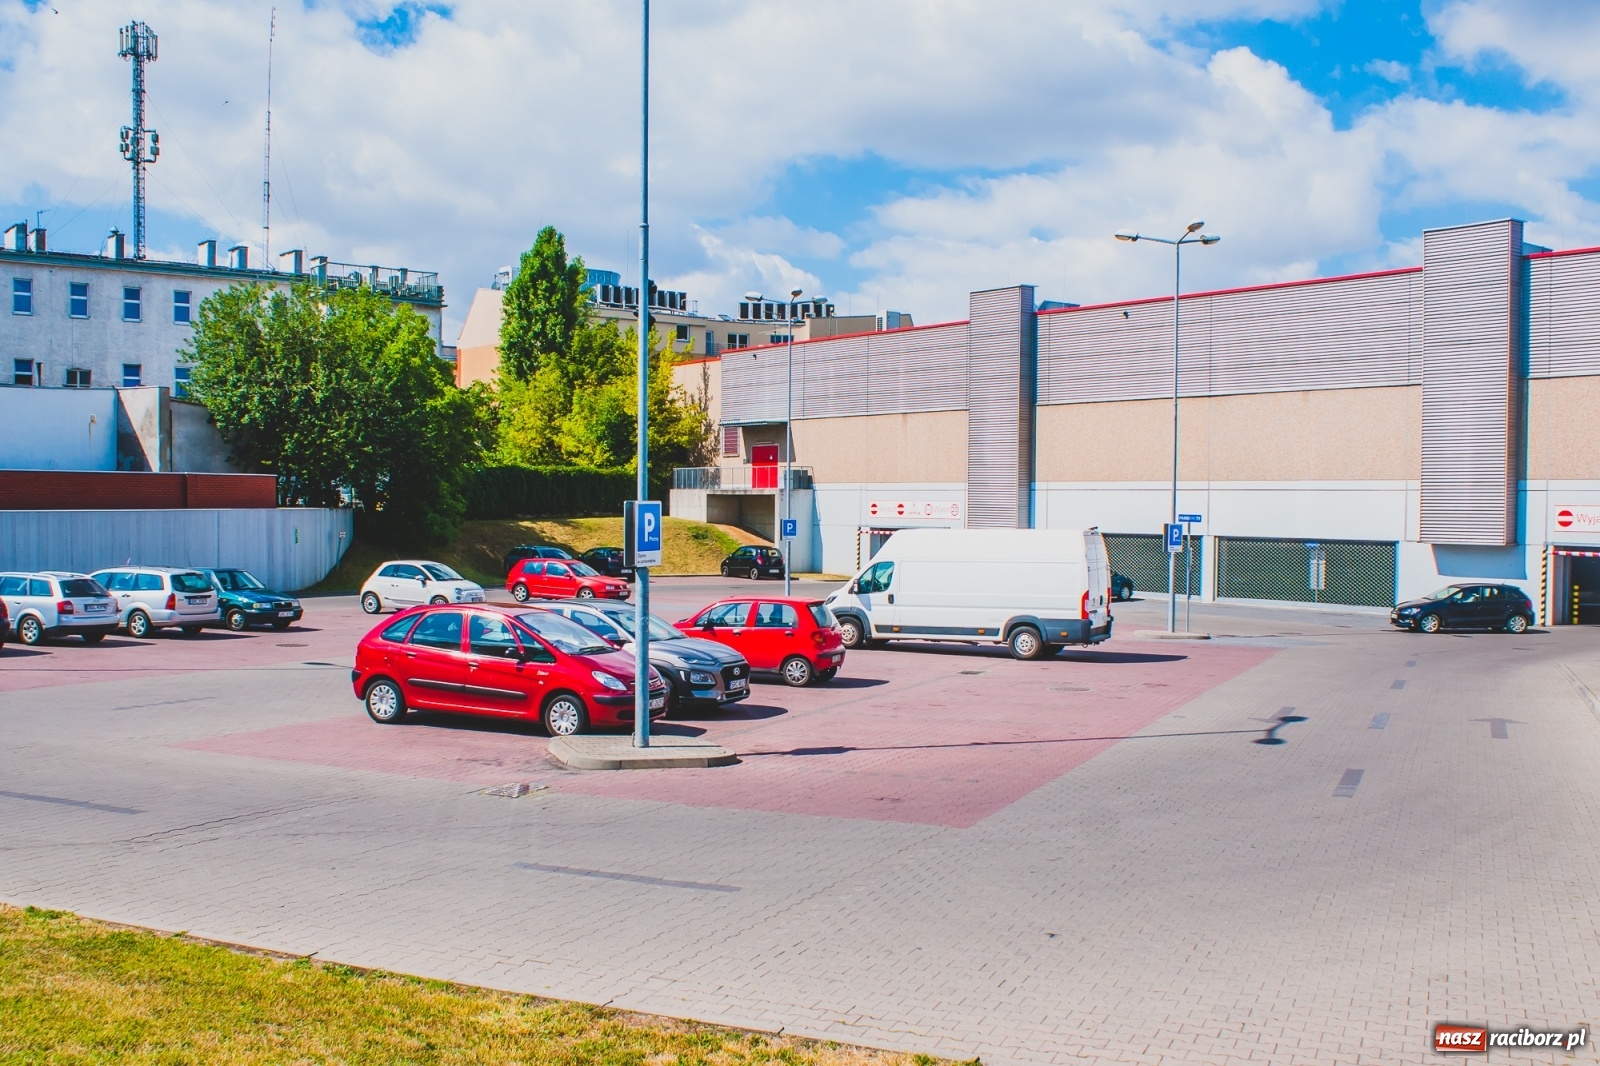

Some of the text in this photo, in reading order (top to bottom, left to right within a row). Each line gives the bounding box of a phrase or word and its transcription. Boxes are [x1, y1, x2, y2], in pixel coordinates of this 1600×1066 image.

[644, 512, 655, 542] P
[787, 523, 793, 532] P
[1173, 529, 1179, 541] P
